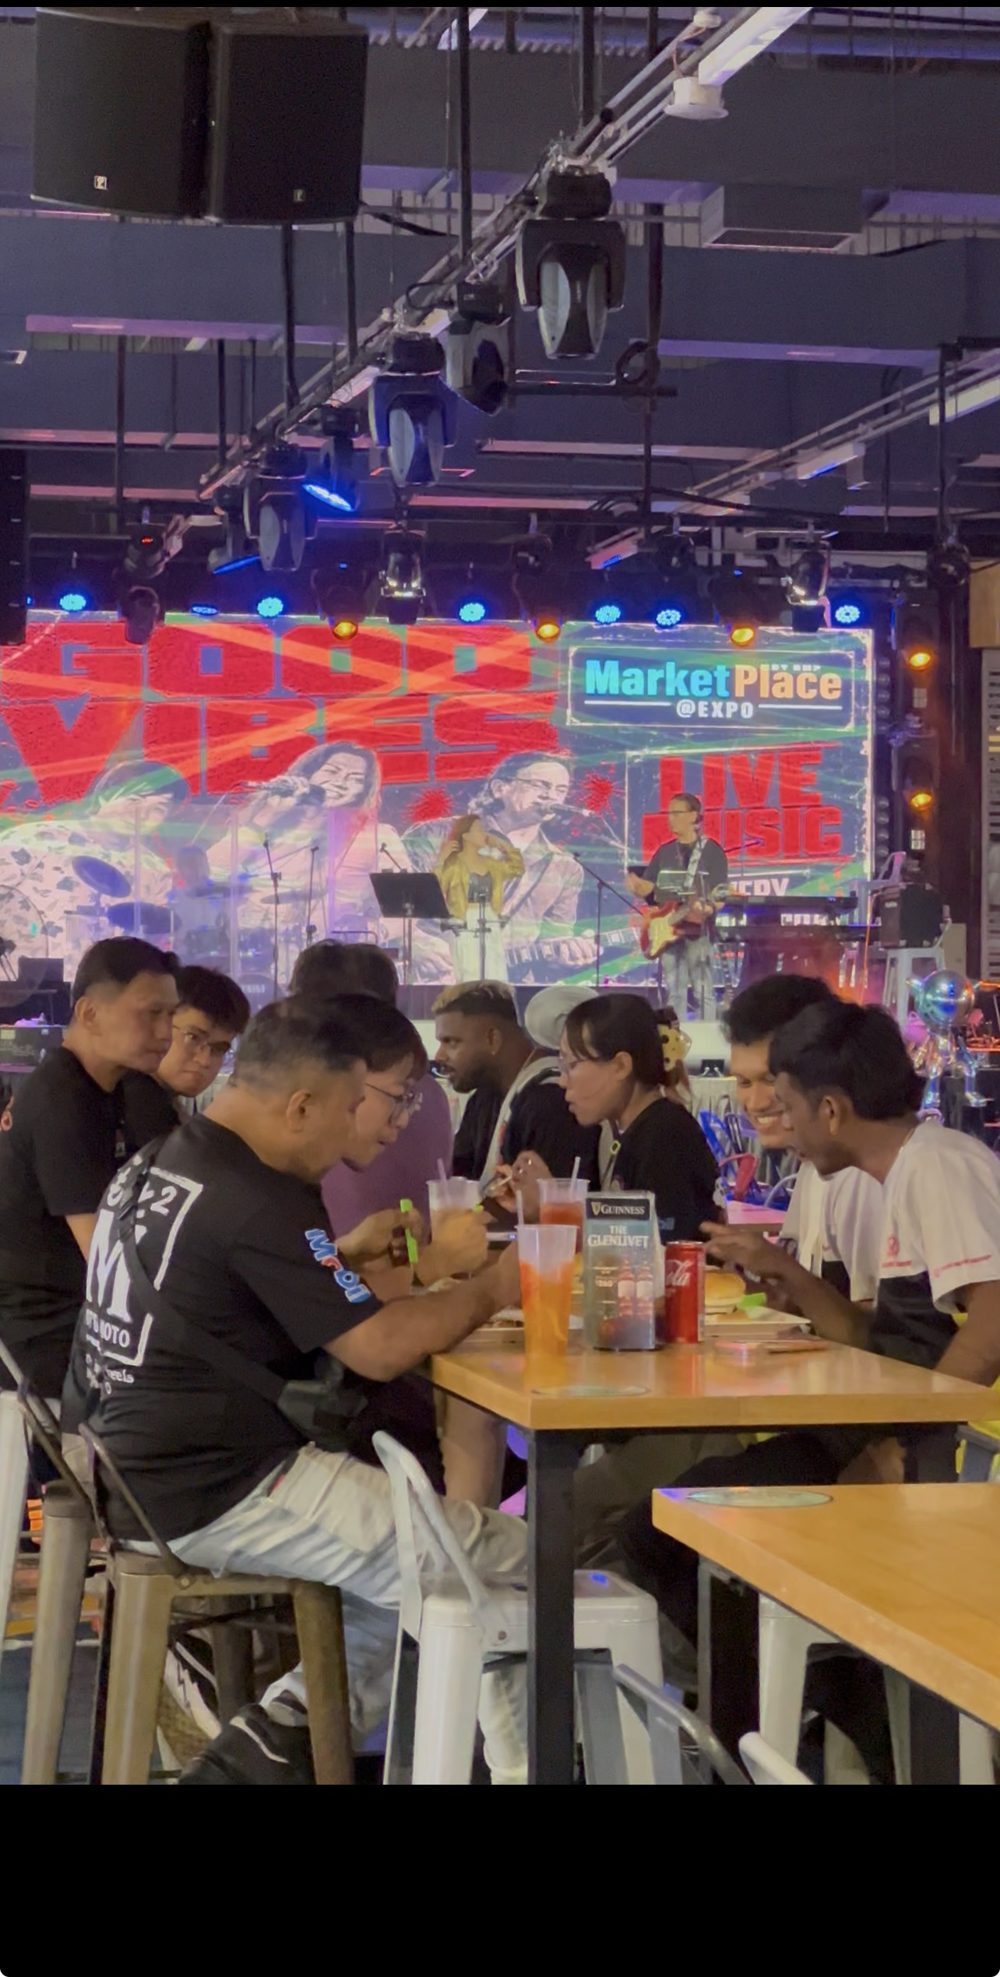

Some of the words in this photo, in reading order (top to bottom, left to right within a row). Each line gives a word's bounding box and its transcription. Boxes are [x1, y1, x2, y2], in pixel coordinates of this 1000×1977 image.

[0, 620, 533, 700] GOOD
[676, 699, 754, 719] @EXPO
[0, 692, 560, 803] VIBES
[660, 751, 822, 812] LIVE
[601, 1205, 645, 1215] GUINNESS
[609, 1225, 628, 1235] THE
[588, 1235, 649, 1249] GLENLIVET
